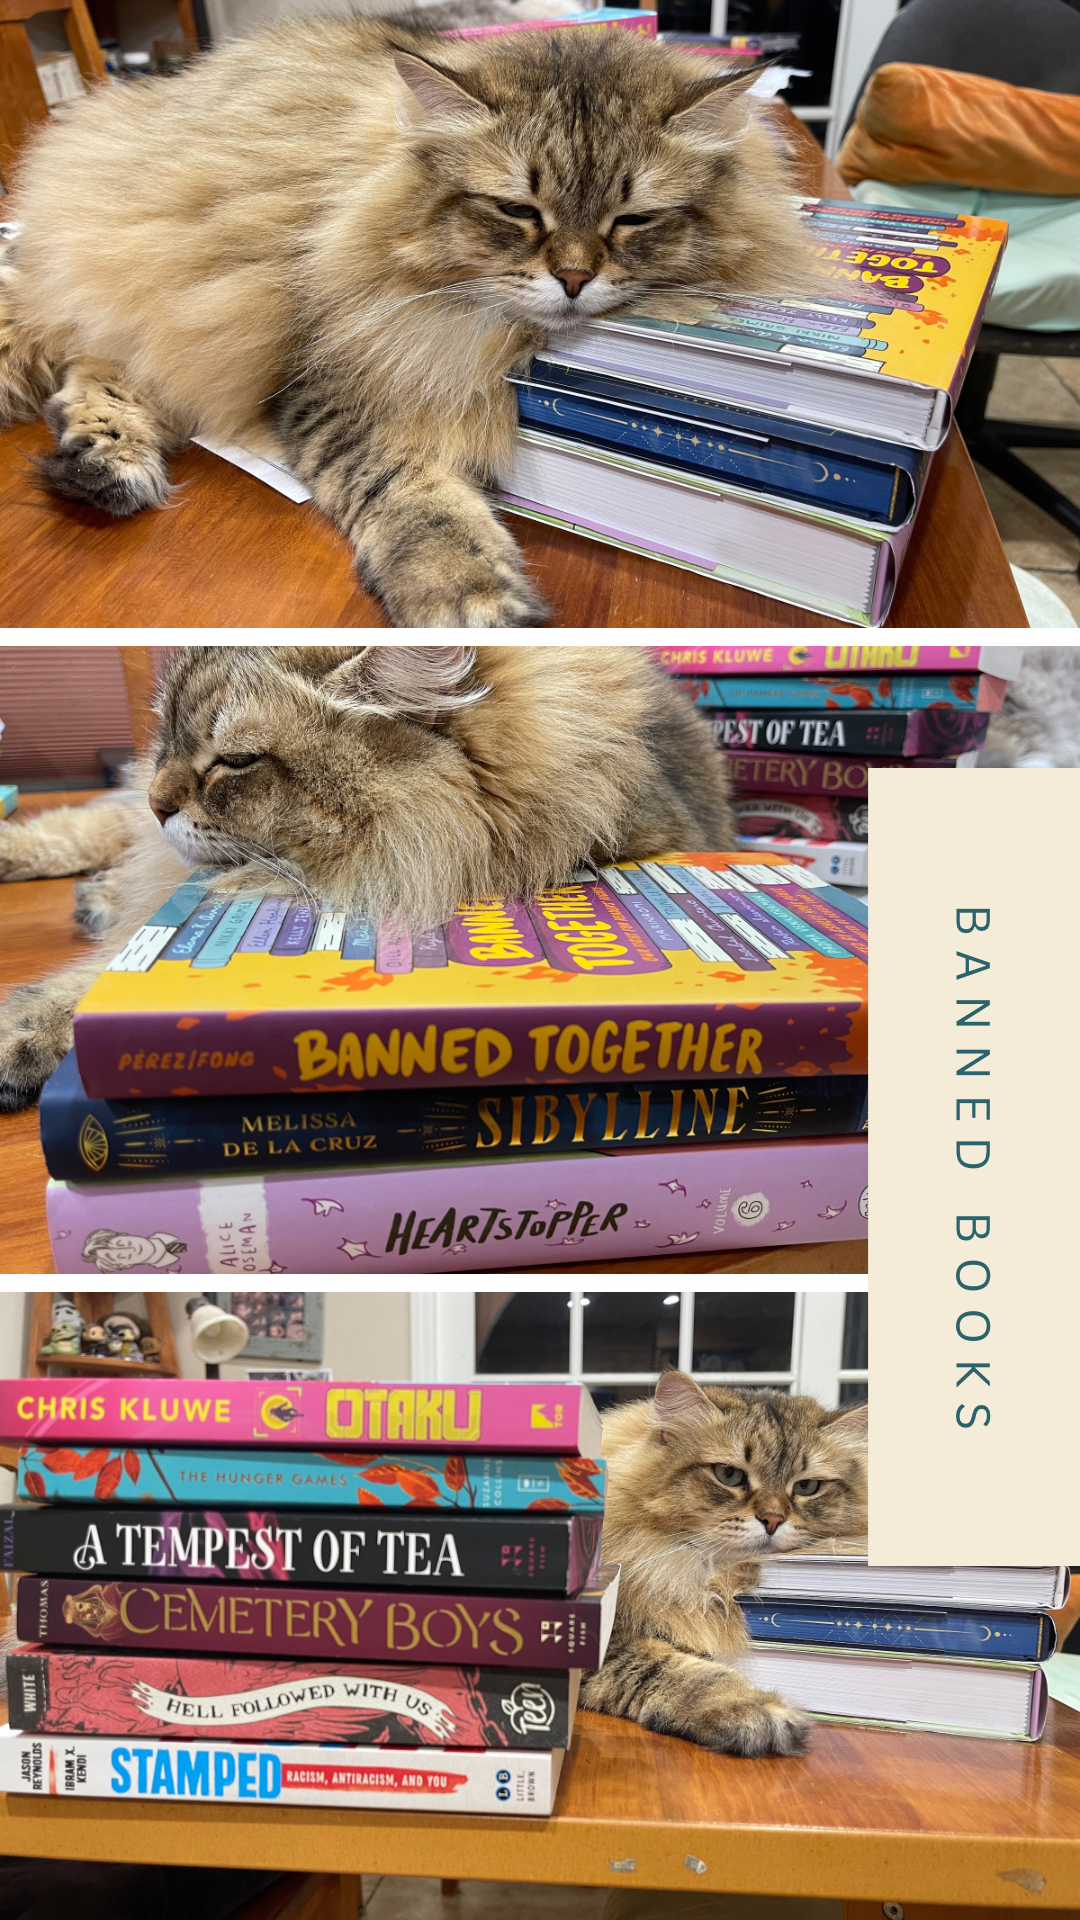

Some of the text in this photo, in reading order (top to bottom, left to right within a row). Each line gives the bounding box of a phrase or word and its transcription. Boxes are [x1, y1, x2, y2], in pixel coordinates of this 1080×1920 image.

[794, 329, 841, 341] NIKKI
[806, 314, 849, 324] KELLY
[660, 650, 707, 665] CHRIS
[713, 648, 774, 664] KLUWE
[712, 718, 847, 747] PEST OF TEA
[214, 901, 254, 946] NIKKI GRIMES
[247, 927, 273, 948] Ellen
[285, 925, 305, 946] KELLY
[631, 901, 674, 941] MARINAOMI
[171, 929, 206, 953] Elana
[805, 933, 842, 954] PADMA
[293, 1019, 764, 1081] BANNED TOGETHER
[241, 1111, 357, 1134] MELISSA
[475, 1086, 750, 1149] SIBYLLINE
[222, 1134, 378, 1157] DE LA CRUZ
[712, 1187, 731, 1235] VOLUME
[219, 1221, 238, 1267] ALICE
[242, 1212, 257, 1272] OSEMAN
[17, 1387, 482, 1442] CHRIS KLUWE OTAKU
[554, 1404, 564, 1429] TOR
[179, 1470, 348, 1487] THE HUNGER GAMES
[73, 1523, 464, 1577] A TEMPEST OF TEA
[38, 1580, 49, 1638] THOMAS
[120, 1587, 524, 1657] CEMETERY BOYS
[568, 1613, 576, 1654] SQUARE
[22, 1673, 37, 1713] WHITE
[165, 1683, 433, 1719] HELL FOLLOWED WITH US
[21, 1751, 32, 1783] JASON
[32, 1742, 43, 1791] REYNOLDS
[65, 1745, 76, 1791] IBRAM X.
[76, 1754, 88, 1784] KENDI
[110, 1747, 282, 1799] STAMPED
[286, 1769, 448, 1789] RACISM, ANTIRACISM, AND YOU
